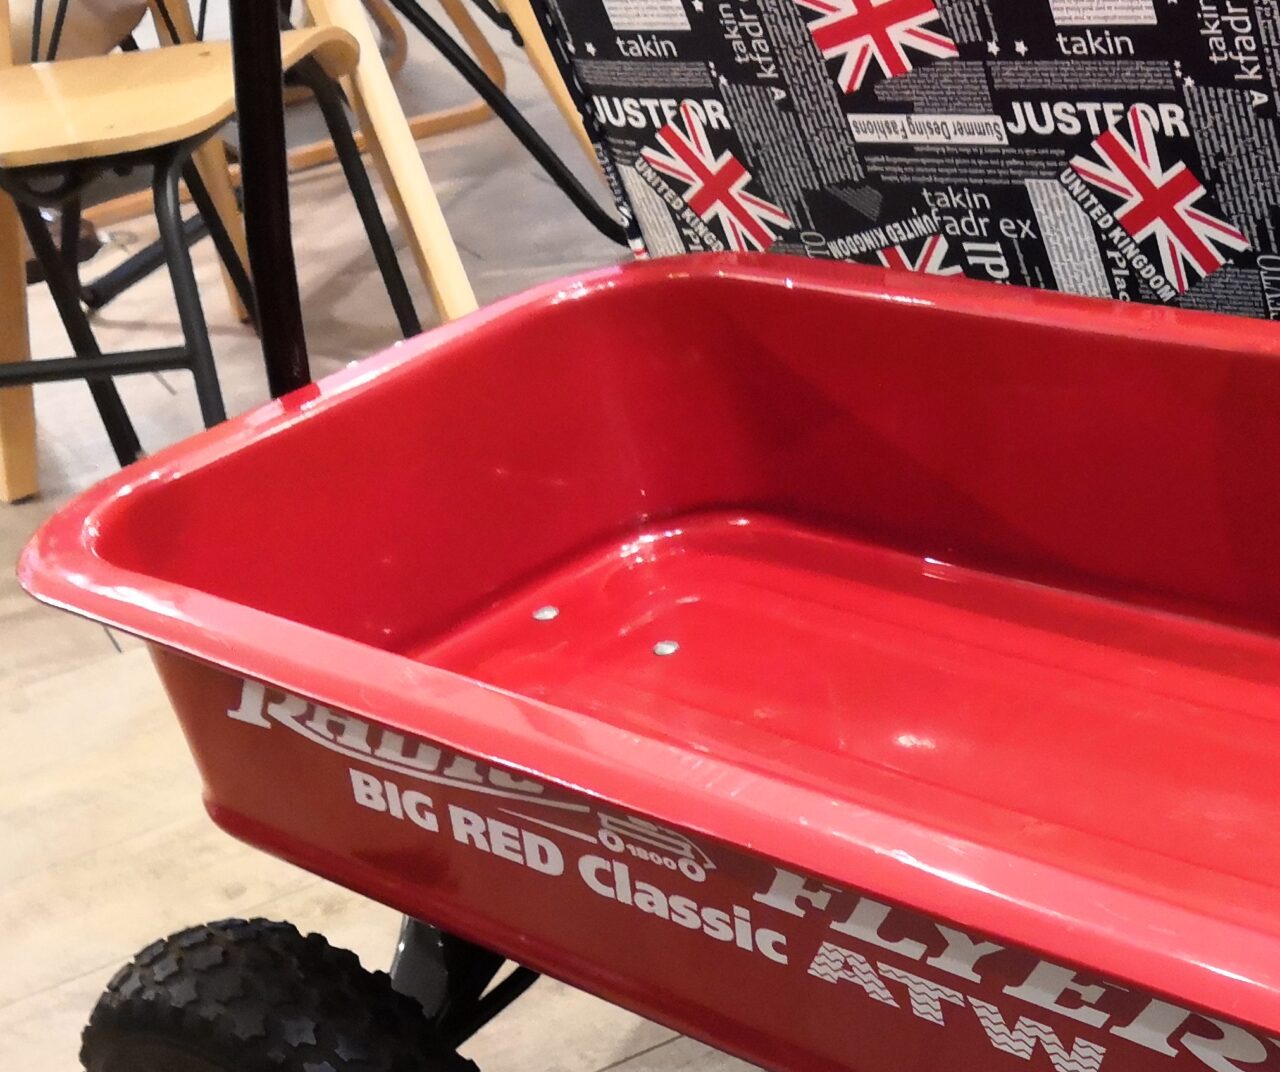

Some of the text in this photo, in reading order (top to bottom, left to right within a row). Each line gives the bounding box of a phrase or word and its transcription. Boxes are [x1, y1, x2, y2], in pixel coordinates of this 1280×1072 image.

[616, 34, 678, 58] takin
[1056, 29, 1134, 55] takin
[852, 120, 907, 140] Fashions
[950, 122, 1002, 142] Summer
[635, 157, 684, 210] UNITED
[681, 206, 725, 252] KINGD
[921, 187, 991, 210] takin
[885, 213, 940, 244] UNITED
[931, 208, 1038, 240] fadr ex
[1059, 167, 1114, 229] UNITED
[1109, 226, 1178, 303] KINGDOM
[826, 226, 885, 259] KINGDOM
[1106, 249, 1130, 302] Plac
[348, 767, 788, 965] BIG RED Classic
